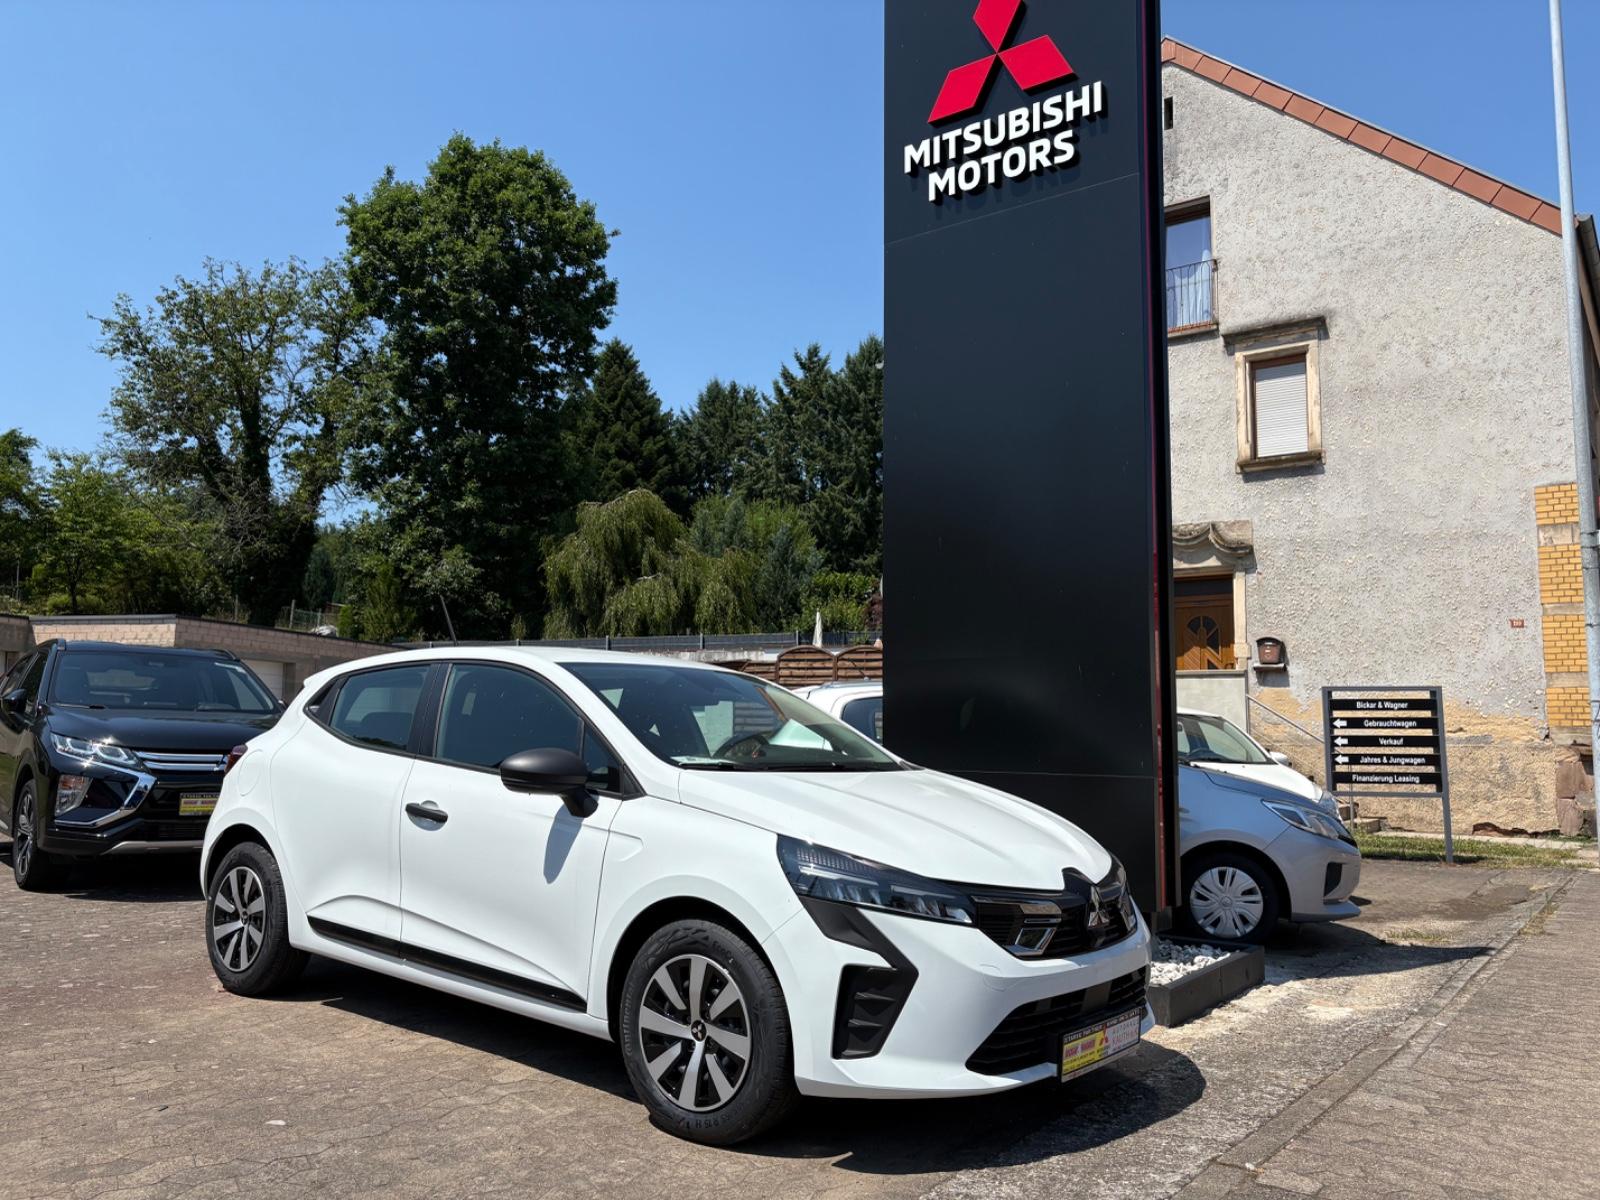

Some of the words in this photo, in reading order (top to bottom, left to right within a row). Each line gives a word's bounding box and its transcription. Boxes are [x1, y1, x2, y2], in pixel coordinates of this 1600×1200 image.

[904, 81, 1103, 174] MITSUBISHI
[928, 130, 1076, 202] MOTORS
[1378, 701, 1383, 709] &
[1384, 702, 1408, 710] Wagner
[1364, 720, 1416, 728] Gebrauchtwagen
[1383, 756, 1388, 764] &
[1389, 756, 1426, 764] Jungwagen
[1352, 774, 1393, 783] Finanzierung
[1394, 774, 1420, 784] Leasing
